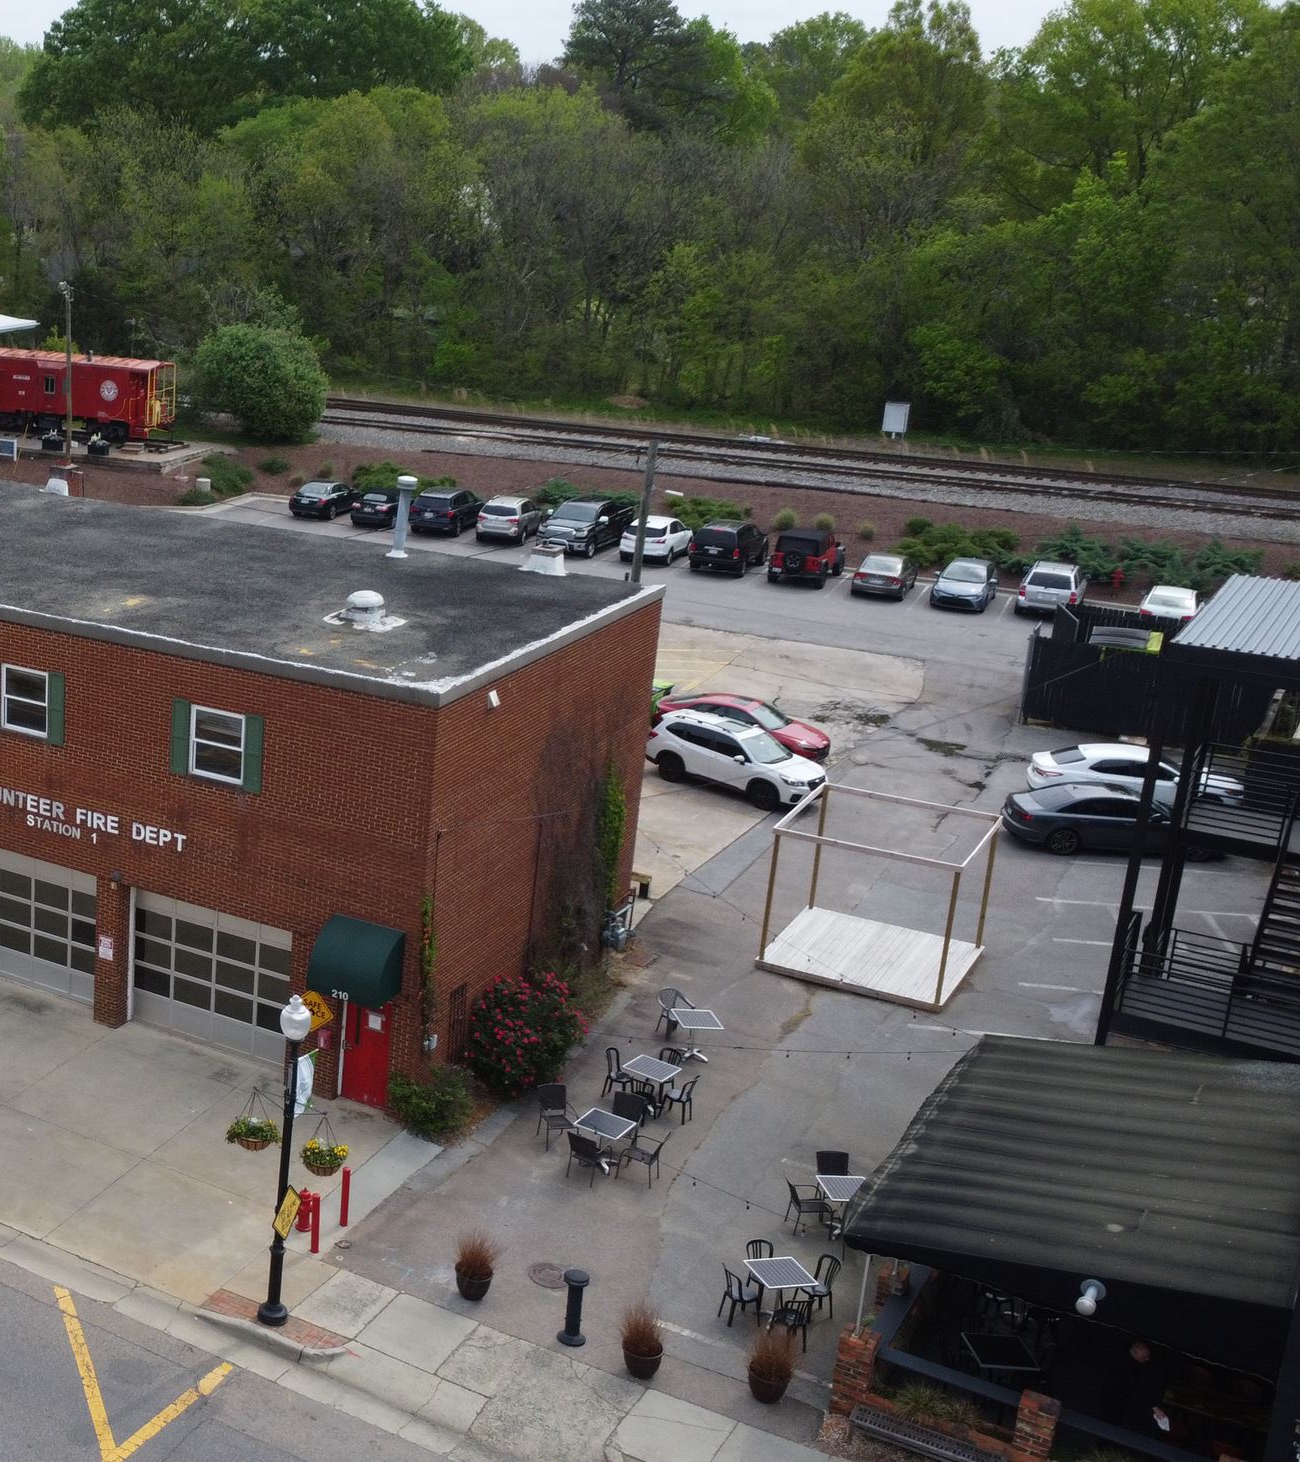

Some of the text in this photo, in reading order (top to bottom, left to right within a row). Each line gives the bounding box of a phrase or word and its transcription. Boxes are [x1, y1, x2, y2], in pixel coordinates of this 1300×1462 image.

[26, 814, 97, 845] STATION 1
[76, 808, 120, 835] FIRE
[132, 822, 187, 852] DEPT
[303, 999, 322, 1011] SAFE
[331, 989, 349, 1001] 210
